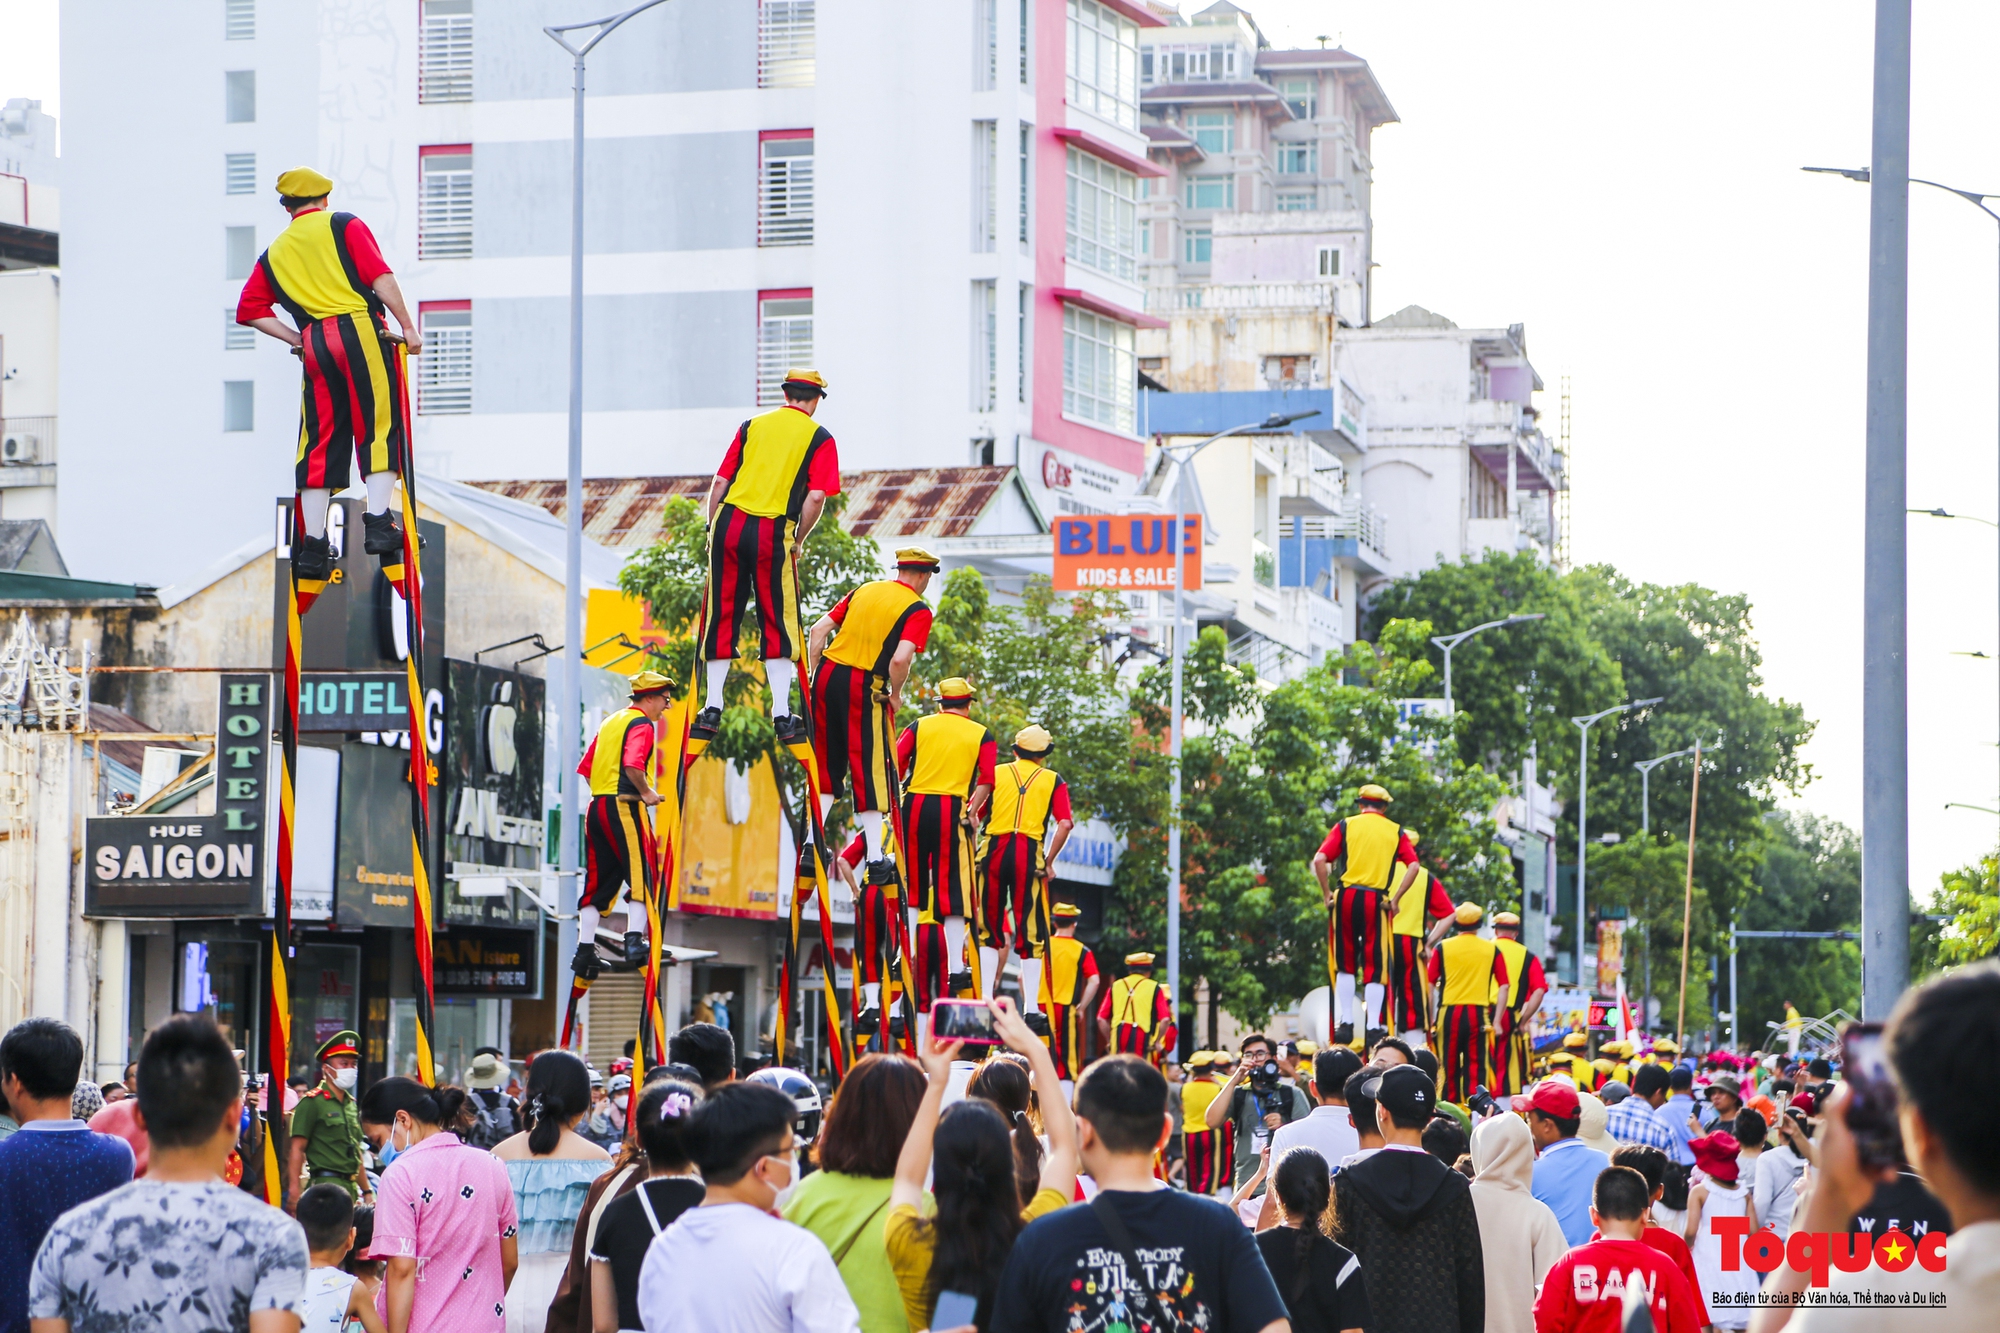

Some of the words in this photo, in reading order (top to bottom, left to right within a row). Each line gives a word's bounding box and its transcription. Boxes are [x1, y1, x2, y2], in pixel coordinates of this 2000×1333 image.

[1059, 520, 1197, 556] BLUE
[298, 682, 408, 715] HOTEL
[225, 683, 262, 831] HOTEL
[149, 825, 203, 838] HUE
[95, 843, 254, 881] SAIGON
